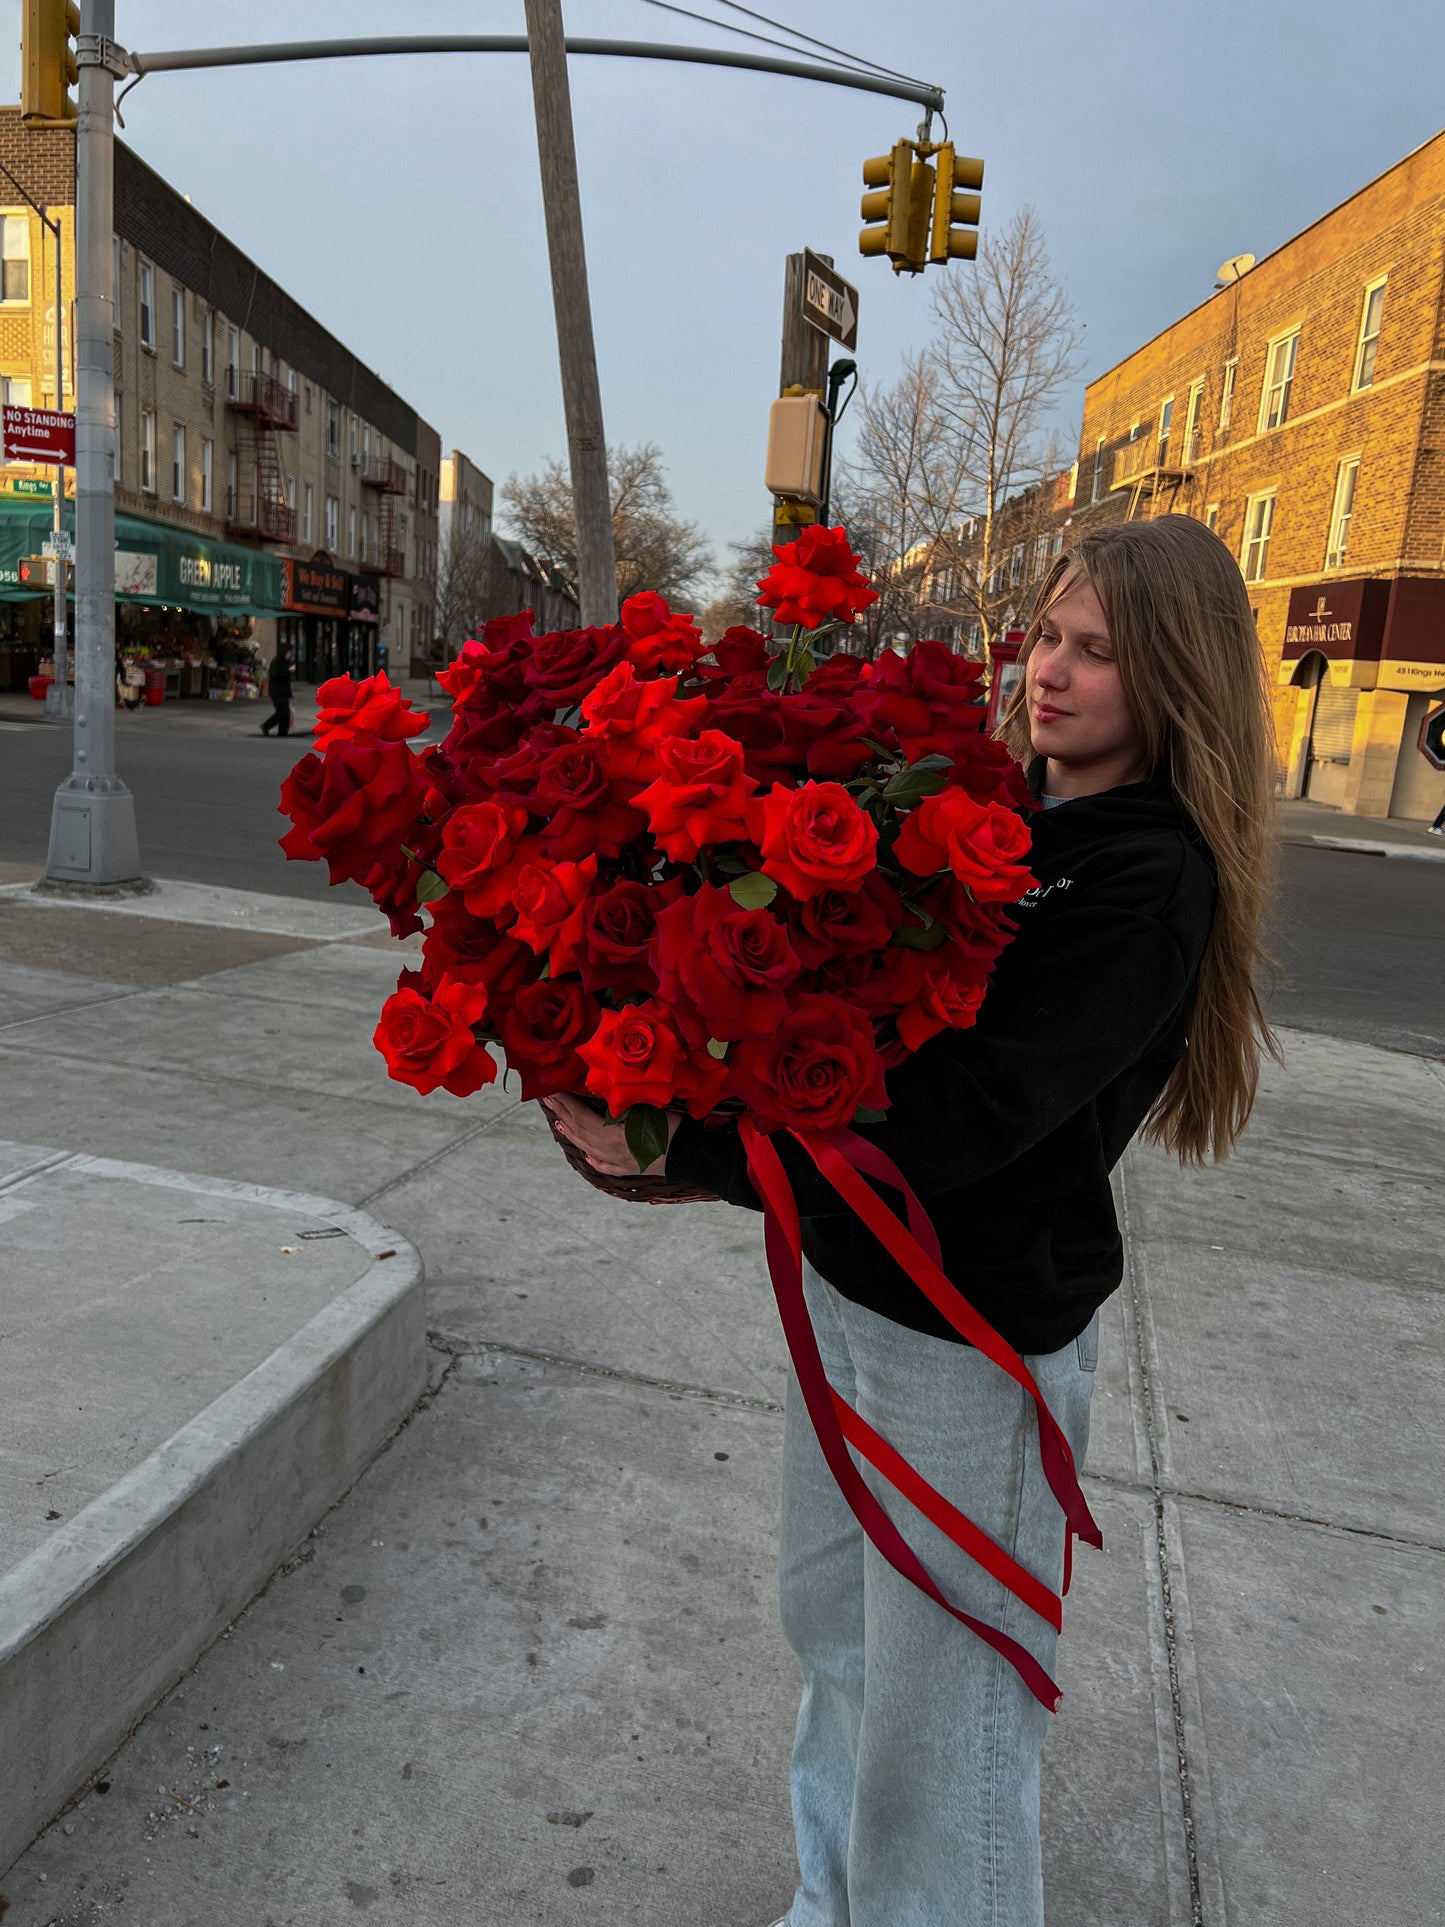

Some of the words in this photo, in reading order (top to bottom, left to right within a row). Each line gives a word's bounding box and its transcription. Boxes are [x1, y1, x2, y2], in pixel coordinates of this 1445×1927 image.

[809, 274, 826, 310] ONE
[829, 288, 845, 322] WAY
[6, 410, 22, 422] NO
[24, 412, 75, 429] STANDING
[7, 422, 51, 438] Anytime
[18, 479, 37, 493] Kings
[180, 556, 211, 587] GREEN
[212, 562, 241, 590] APPLE
[1327, 622, 1352, 642] CENTER
